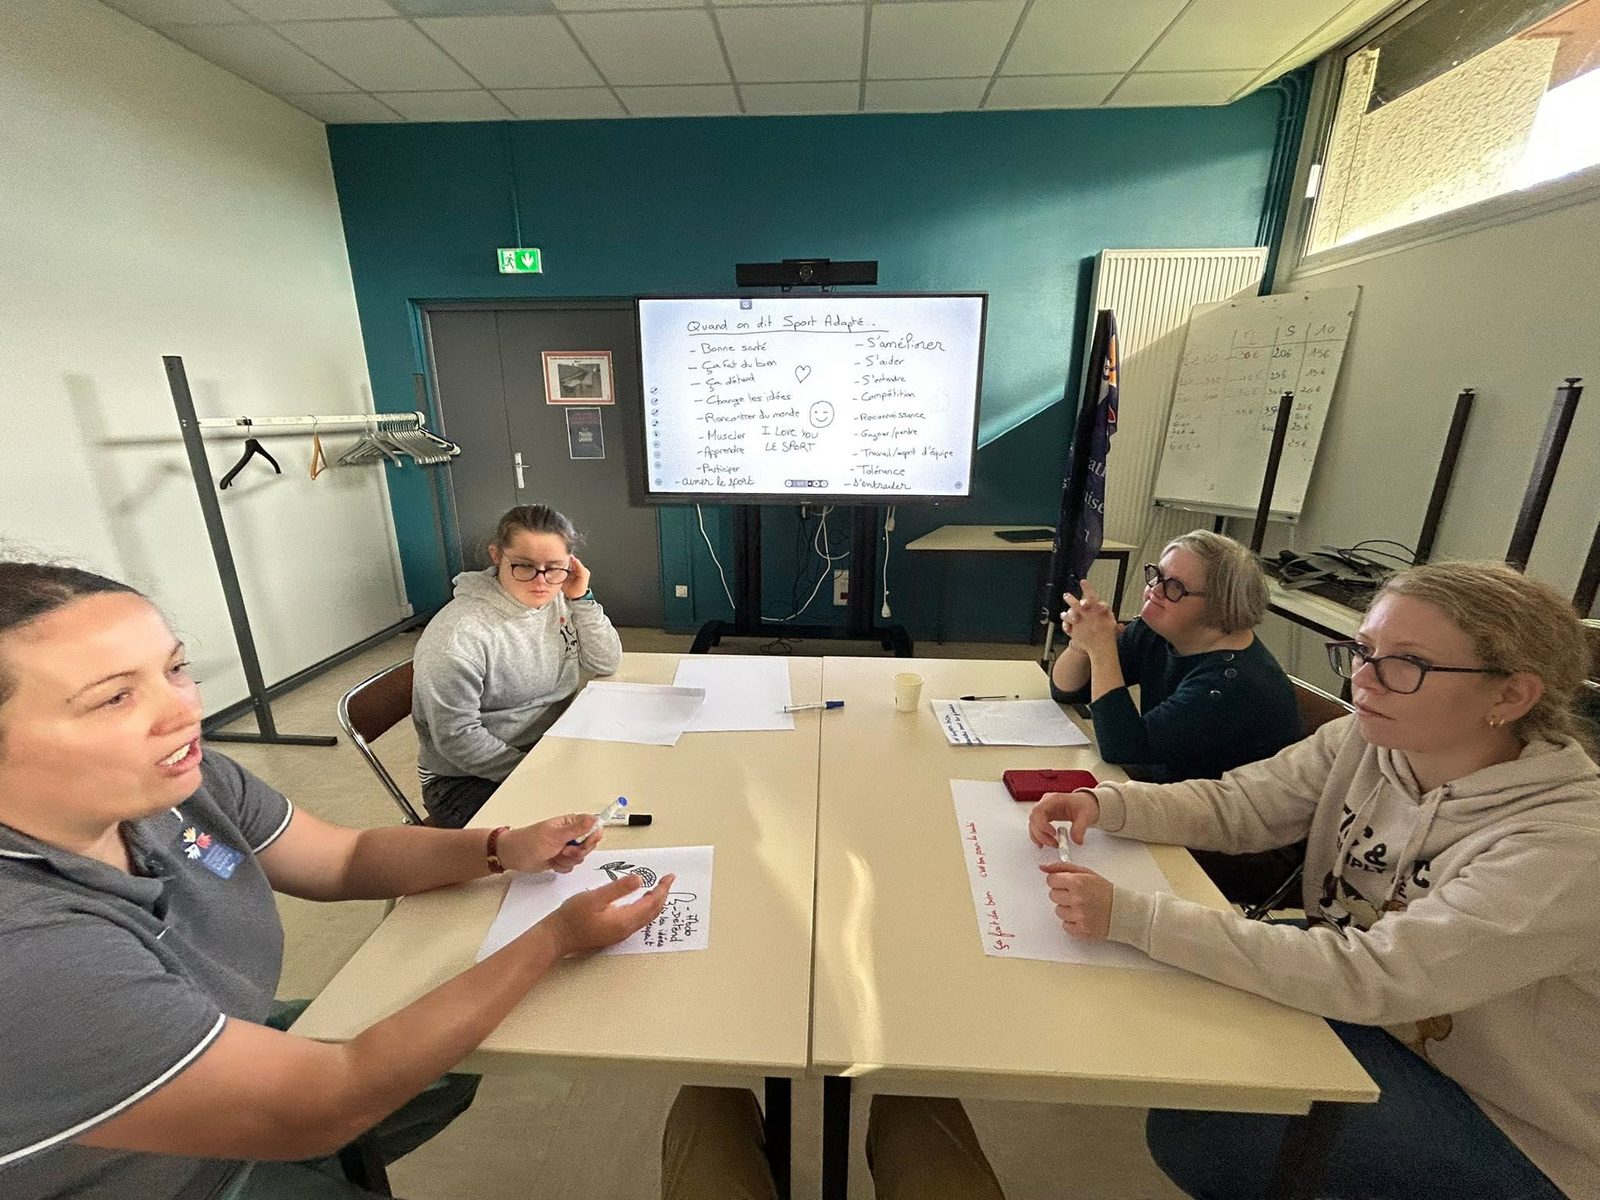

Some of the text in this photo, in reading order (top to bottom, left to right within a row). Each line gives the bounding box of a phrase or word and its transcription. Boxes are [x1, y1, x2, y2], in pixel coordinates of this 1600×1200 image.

[686, 319, 728, 332] Quand
[756, 314, 772, 328] dit
[782, 315, 817, 331] Sport
[701, 340, 767, 354] Bonne santé
[867, 332, 946, 352] S'améliorer
[741, 359, 752, 369] du
[865, 354, 905, 367] S'aider
[725, 372, 756, 385] détend
[706, 390, 792, 408] Change les idées
[861, 388, 916, 402] Compétition
[758, 408, 771, 420] du
[772, 407, 800, 419] monde
[707, 428, 746, 441] Muscler
[761, 425, 771, 436] I
[704, 444, 745, 459] Apprendre
[765, 440, 816, 453] LE SPORT
[921, 445, 954, 460] d'équipe
[702, 463, 741, 475] Participer
[856, 464, 906, 477] Tolérance
[681, 475, 755, 488] aimer le sport
[1363, 842, 1388, 867] &
[670, 911, 684, 942] Détend
[685, 914, 699, 936] Abdo
[657, 929, 669, 948] idées
